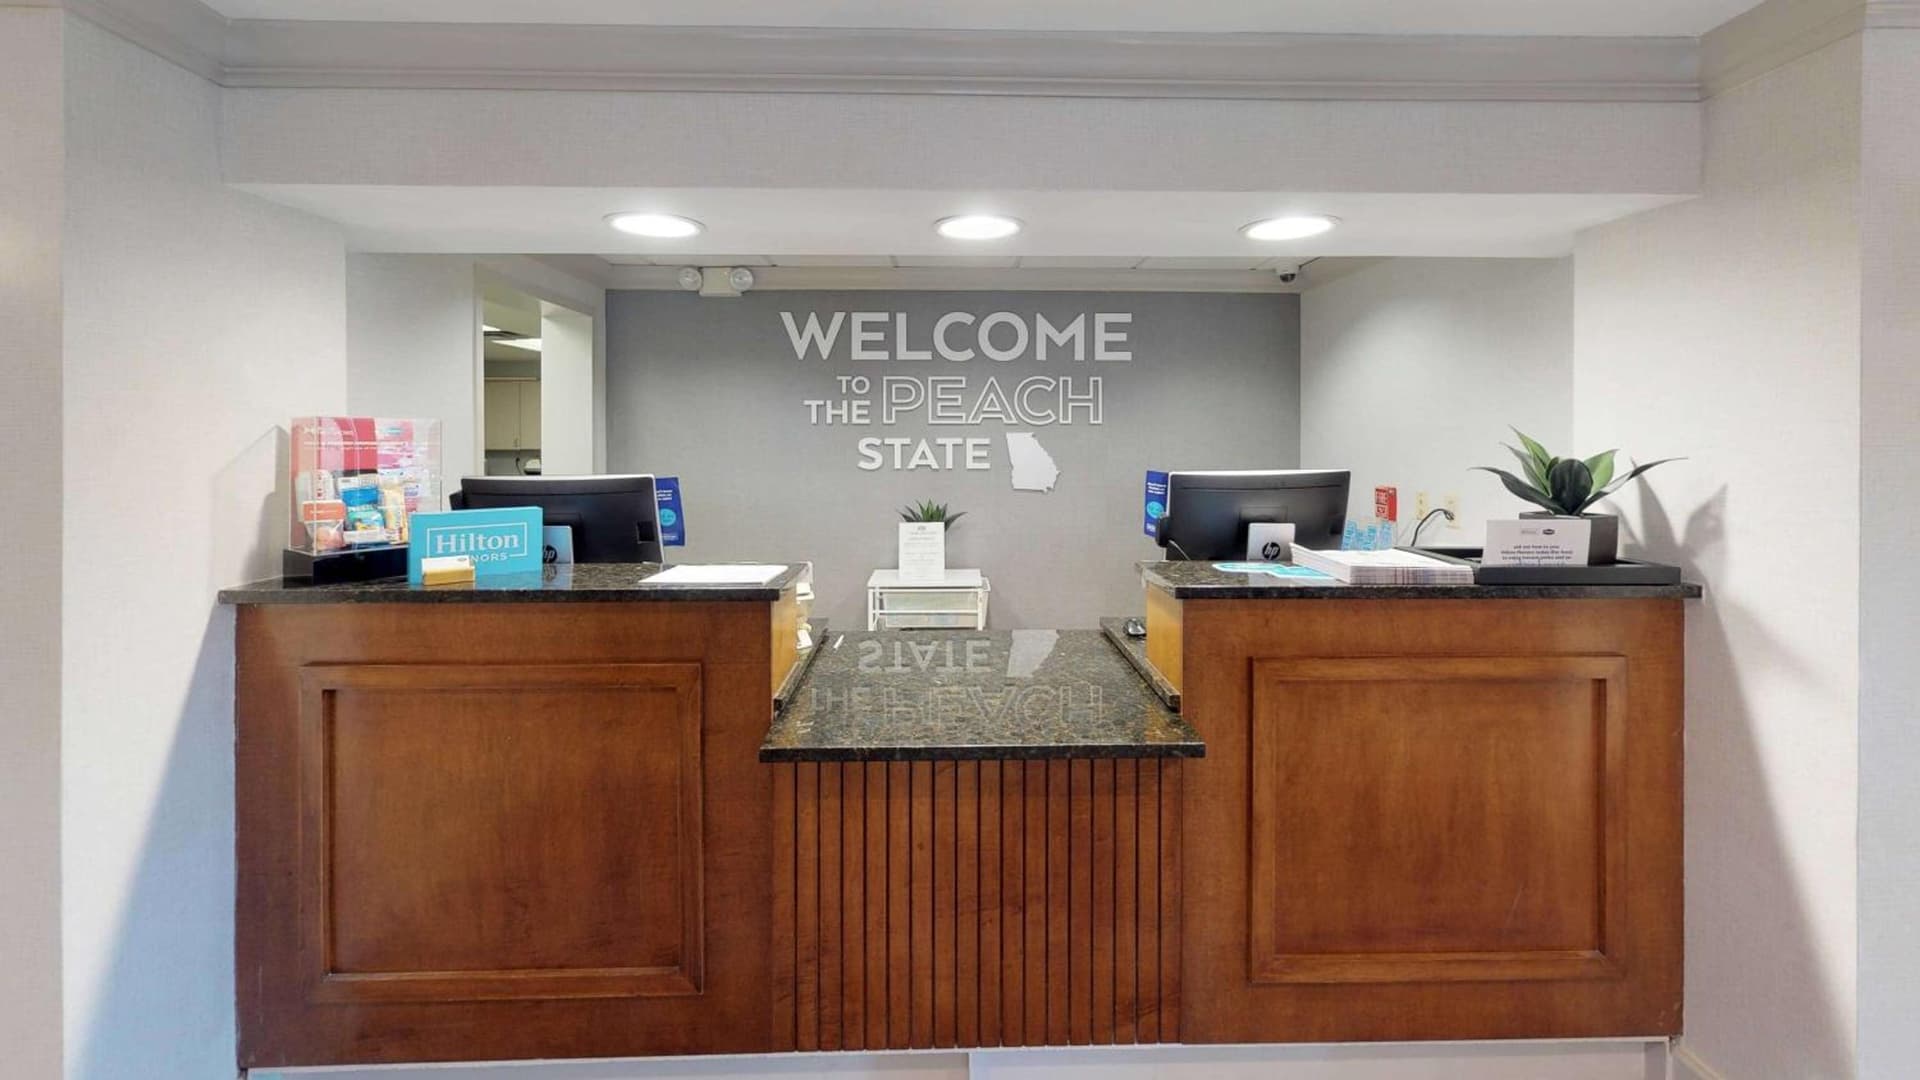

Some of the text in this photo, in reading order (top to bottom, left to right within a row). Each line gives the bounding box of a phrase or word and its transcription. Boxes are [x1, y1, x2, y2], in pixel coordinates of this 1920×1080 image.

[779, 311, 1133, 362] WELCOME
[836, 376, 870, 395] TO
[804, 376, 1103, 426] THE PEACH
[857, 437, 991, 471] STATE
[436, 533, 519, 554] Hilton
[1262, 542, 1280, 561] hp
[469, 551, 508, 562] NORS
